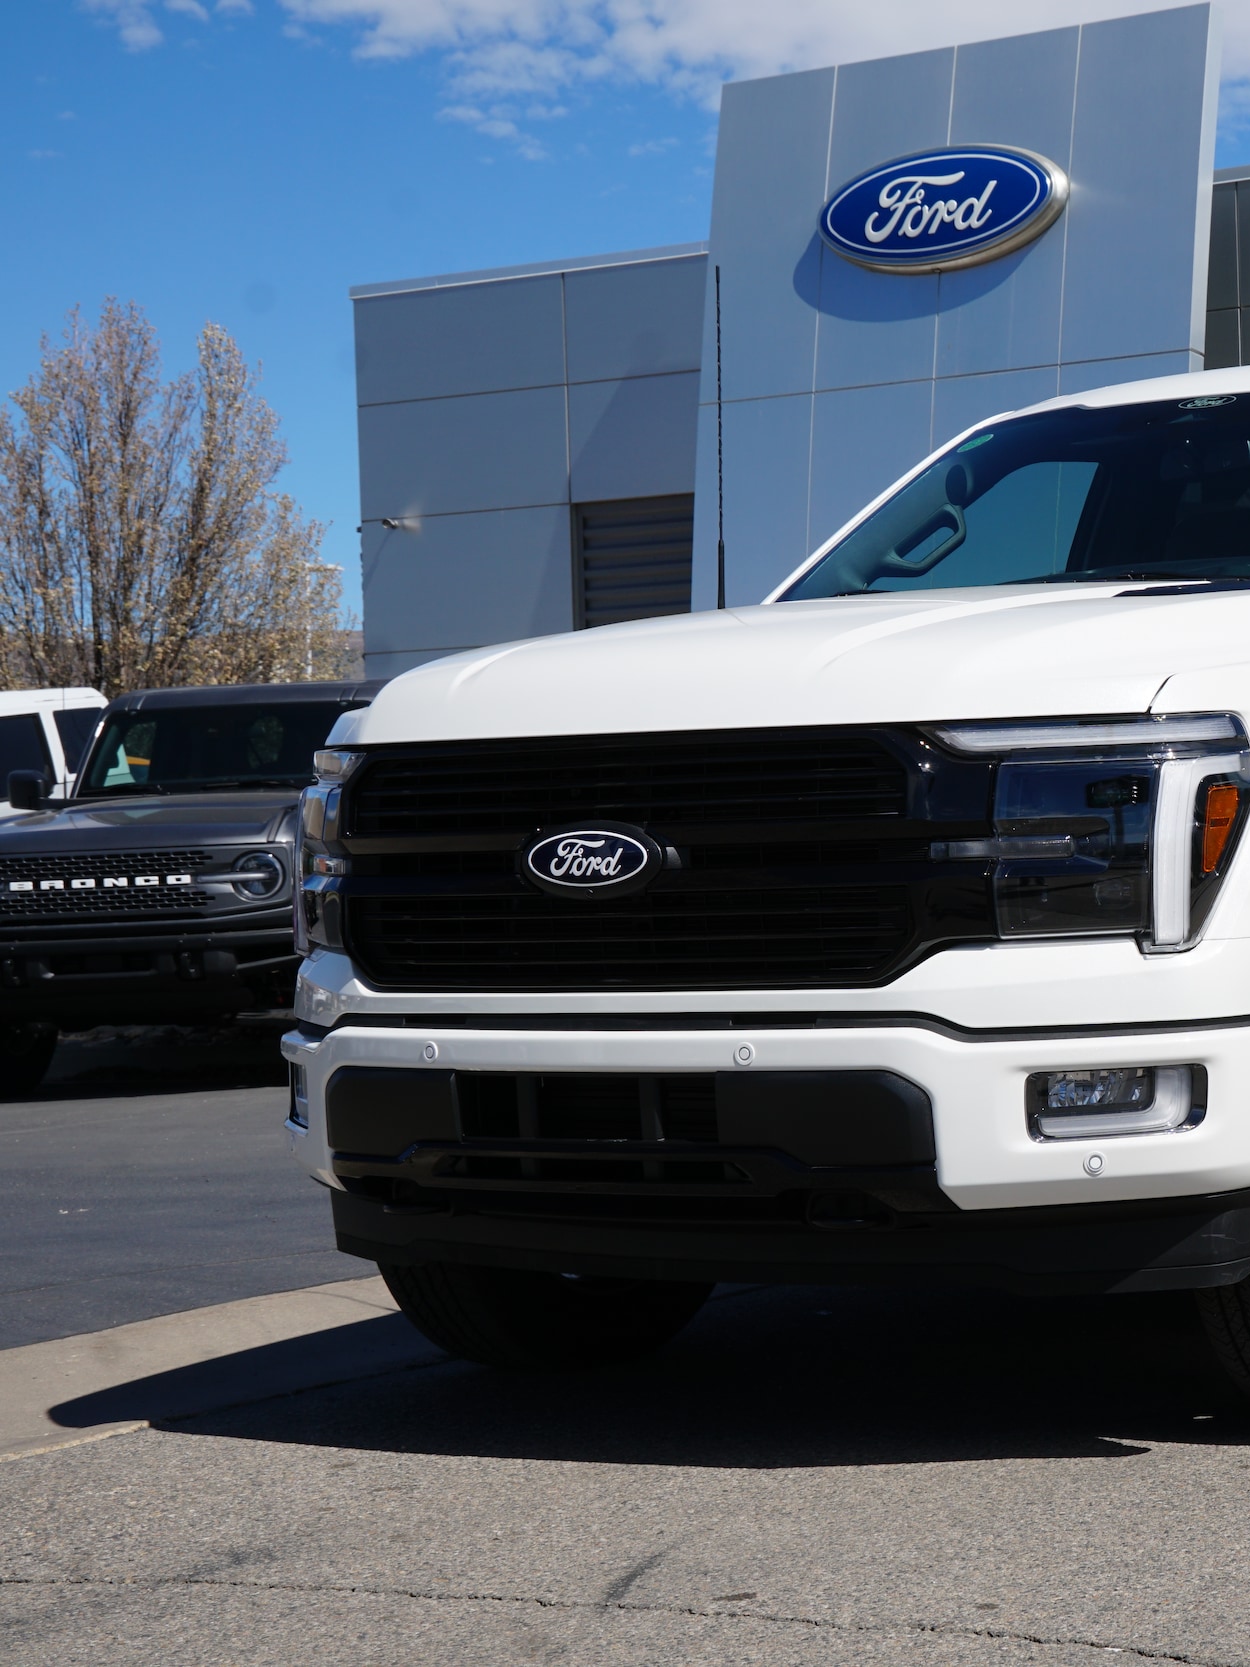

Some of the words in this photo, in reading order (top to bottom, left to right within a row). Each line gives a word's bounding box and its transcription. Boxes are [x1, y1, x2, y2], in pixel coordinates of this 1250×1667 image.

[864, 170, 998, 243] Ford
[1186, 396, 1228, 408] Ford
[549, 838, 624, 877] Ford
[9, 874, 192, 892] BRONCO
